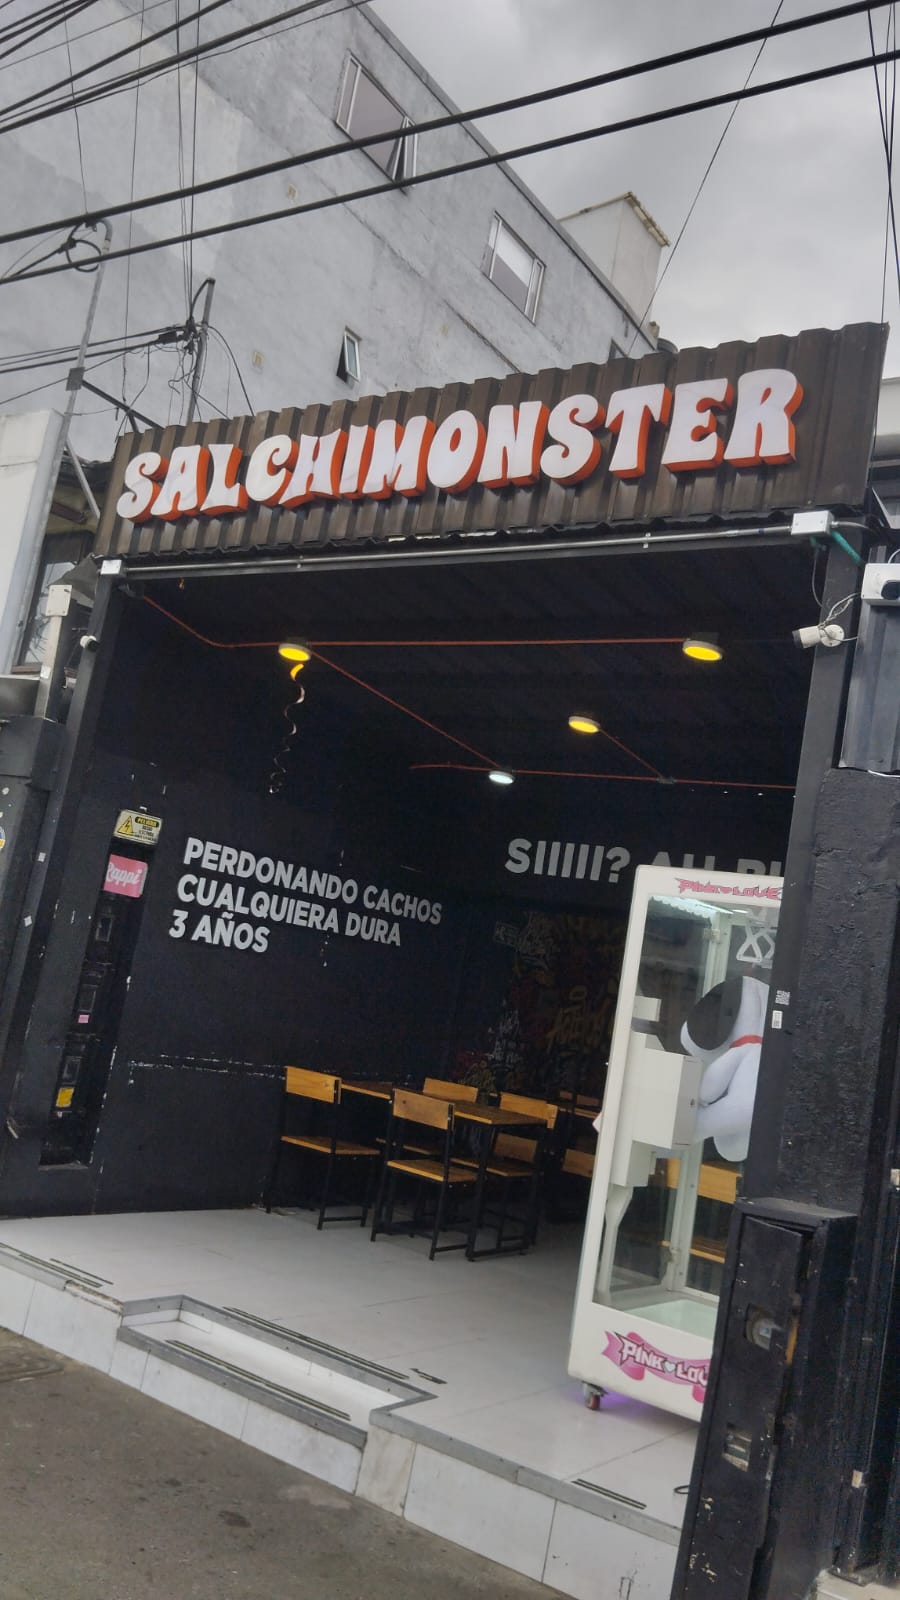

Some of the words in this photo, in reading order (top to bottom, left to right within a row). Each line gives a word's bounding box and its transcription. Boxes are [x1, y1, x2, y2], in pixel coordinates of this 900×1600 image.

[116, 368, 803, 523] SALCHIMONSTER
[183, 837, 358, 904] PERDONANDO
[363, 886, 443, 925] CACHOS
[504, 838, 631, 883] SIIIII?
[169, 909, 188, 938] 3
[192, 912, 270, 952] AÑOS
[177, 874, 339, 933] CUALQUIERA
[345, 912, 401, 946] DURA
[618, 1337, 665, 1372] PINK
